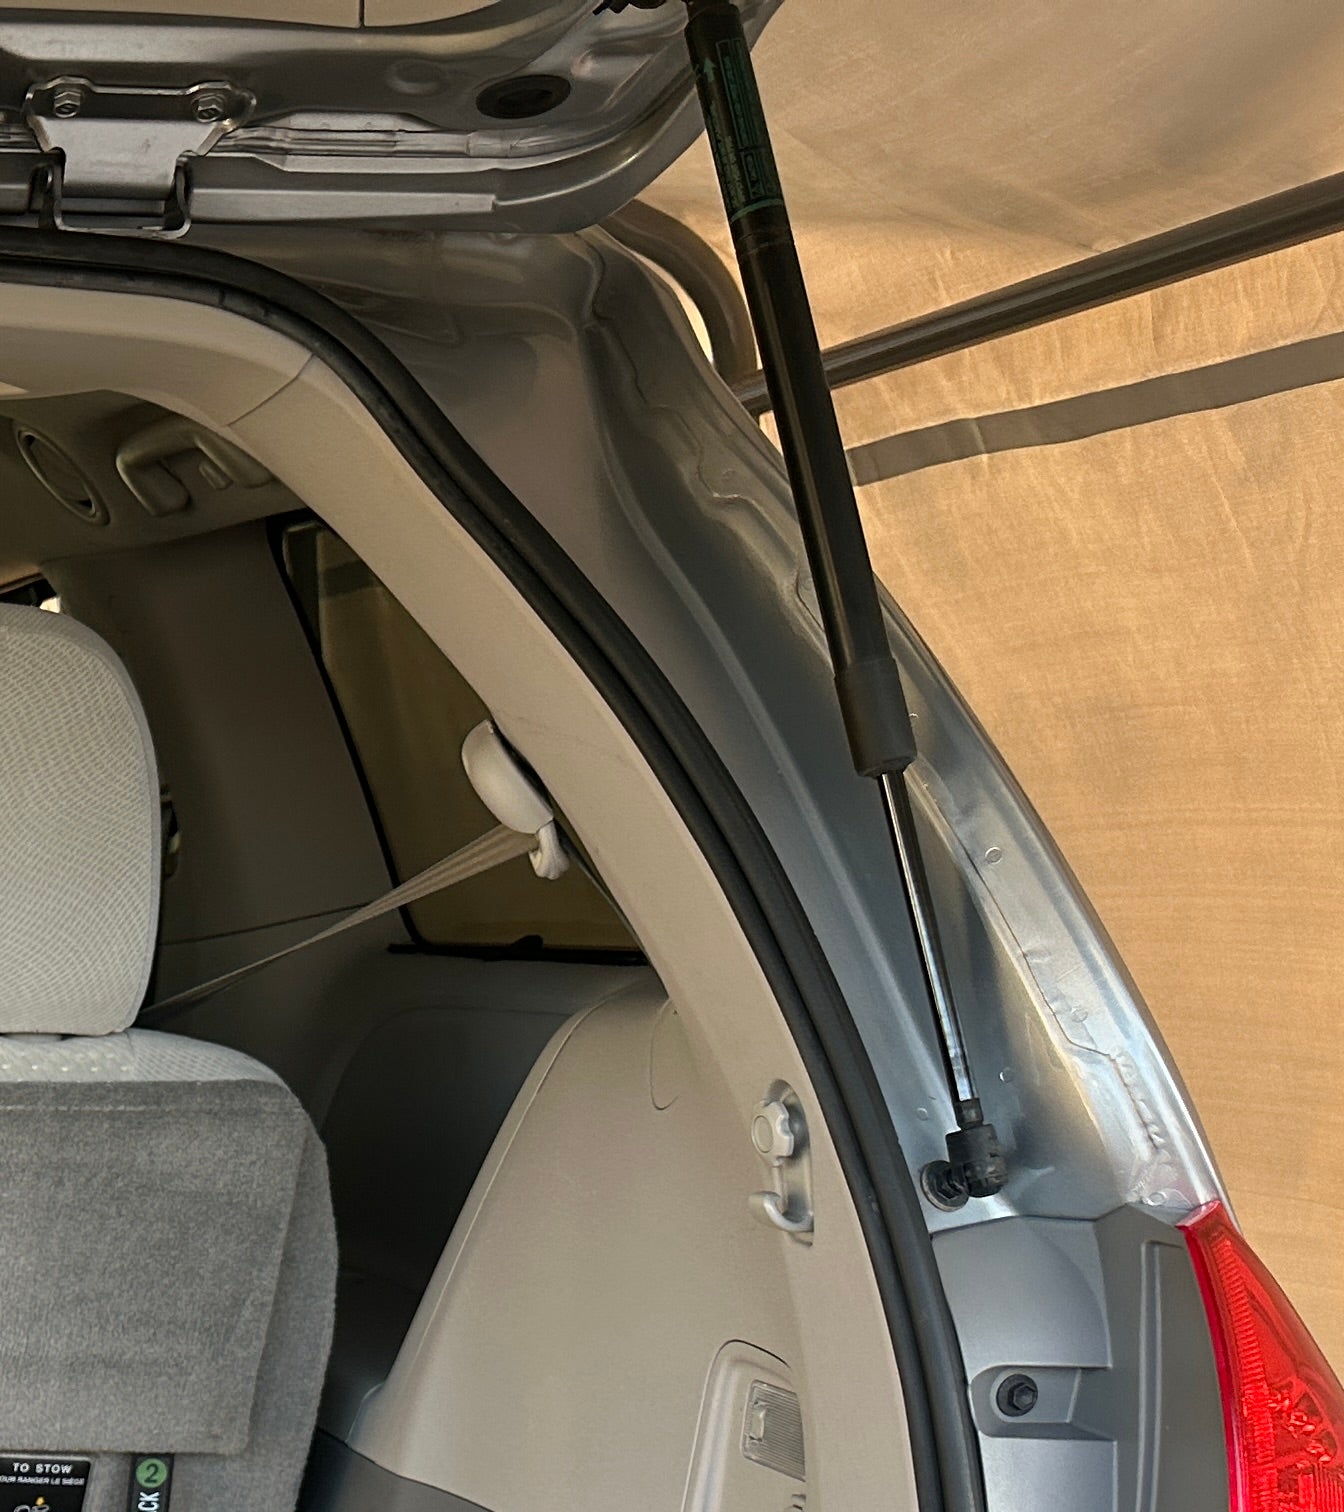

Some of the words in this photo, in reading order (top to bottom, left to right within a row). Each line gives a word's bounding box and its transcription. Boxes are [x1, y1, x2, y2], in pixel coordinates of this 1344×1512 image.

[13, 1462, 30, 1473] TO
[35, 1463, 72, 1474] STOW
[145, 1463, 159, 1484] 2
